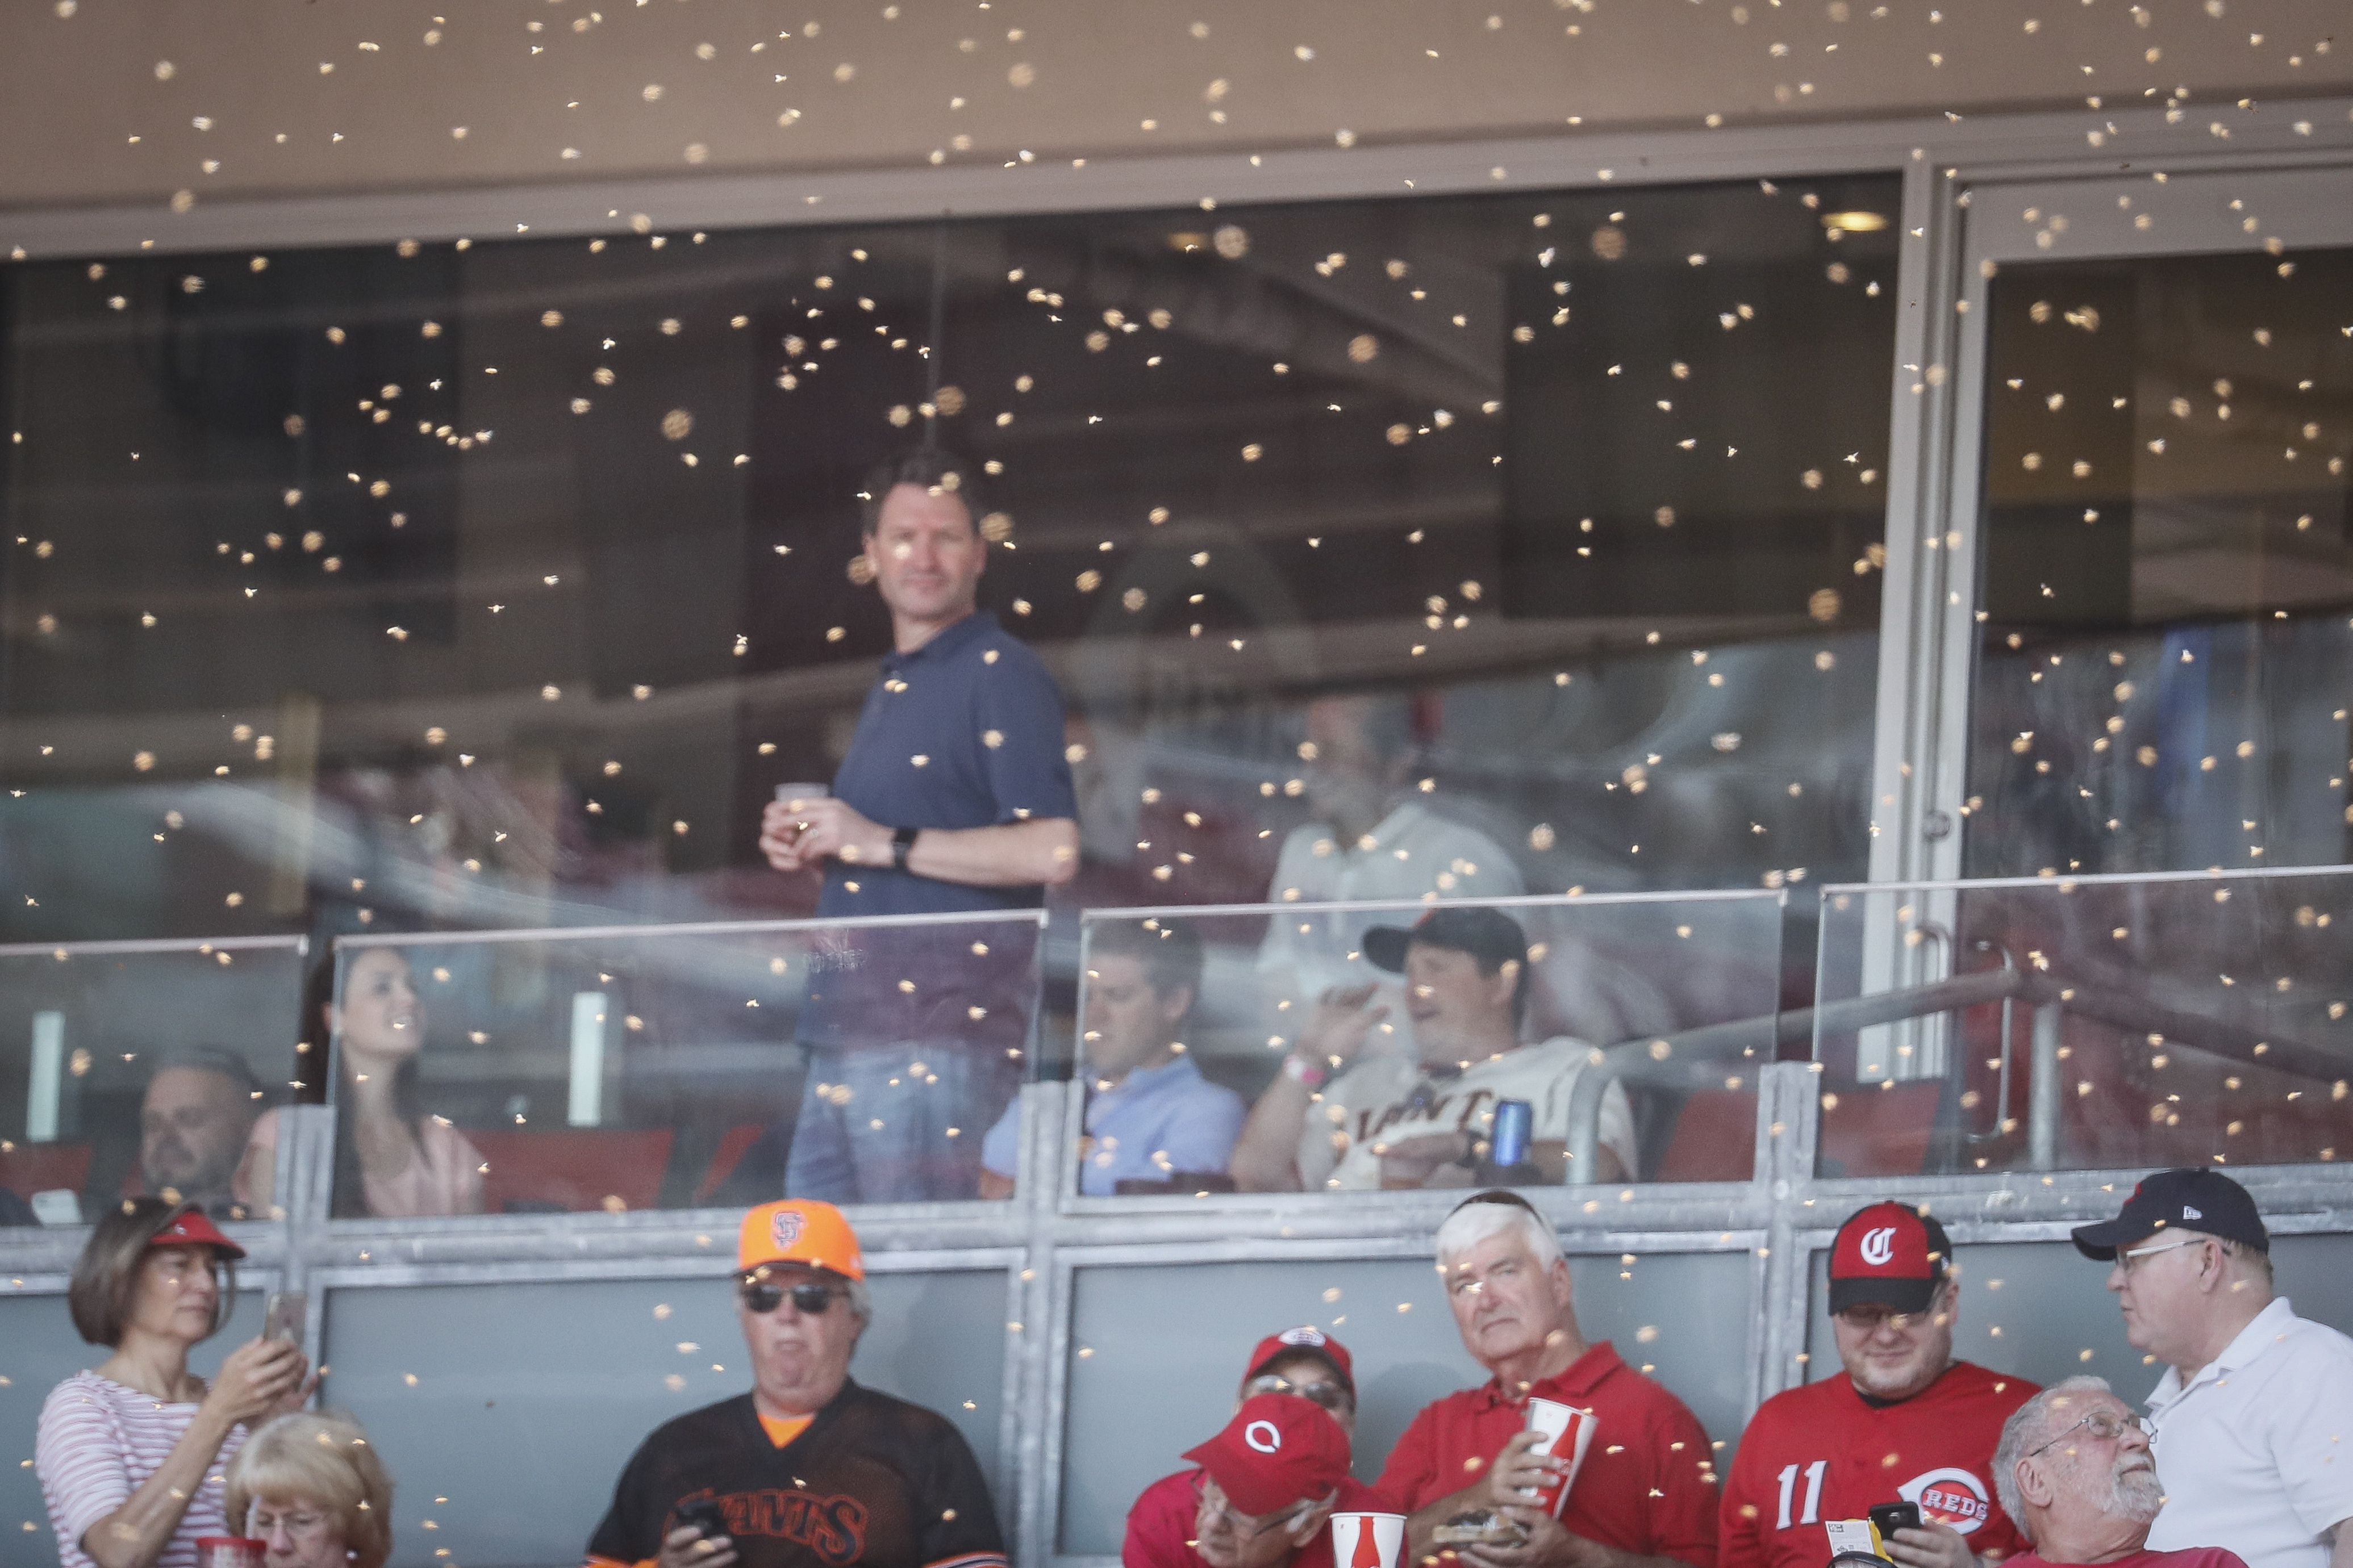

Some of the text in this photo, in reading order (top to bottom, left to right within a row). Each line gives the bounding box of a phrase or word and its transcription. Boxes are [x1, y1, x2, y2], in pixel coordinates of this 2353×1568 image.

[1860, 1227, 1897, 1266] C
[1245, 1419, 1282, 1454] C
[1776, 1460, 1829, 1531] 11
[1922, 1488, 1988, 1521] REDS
